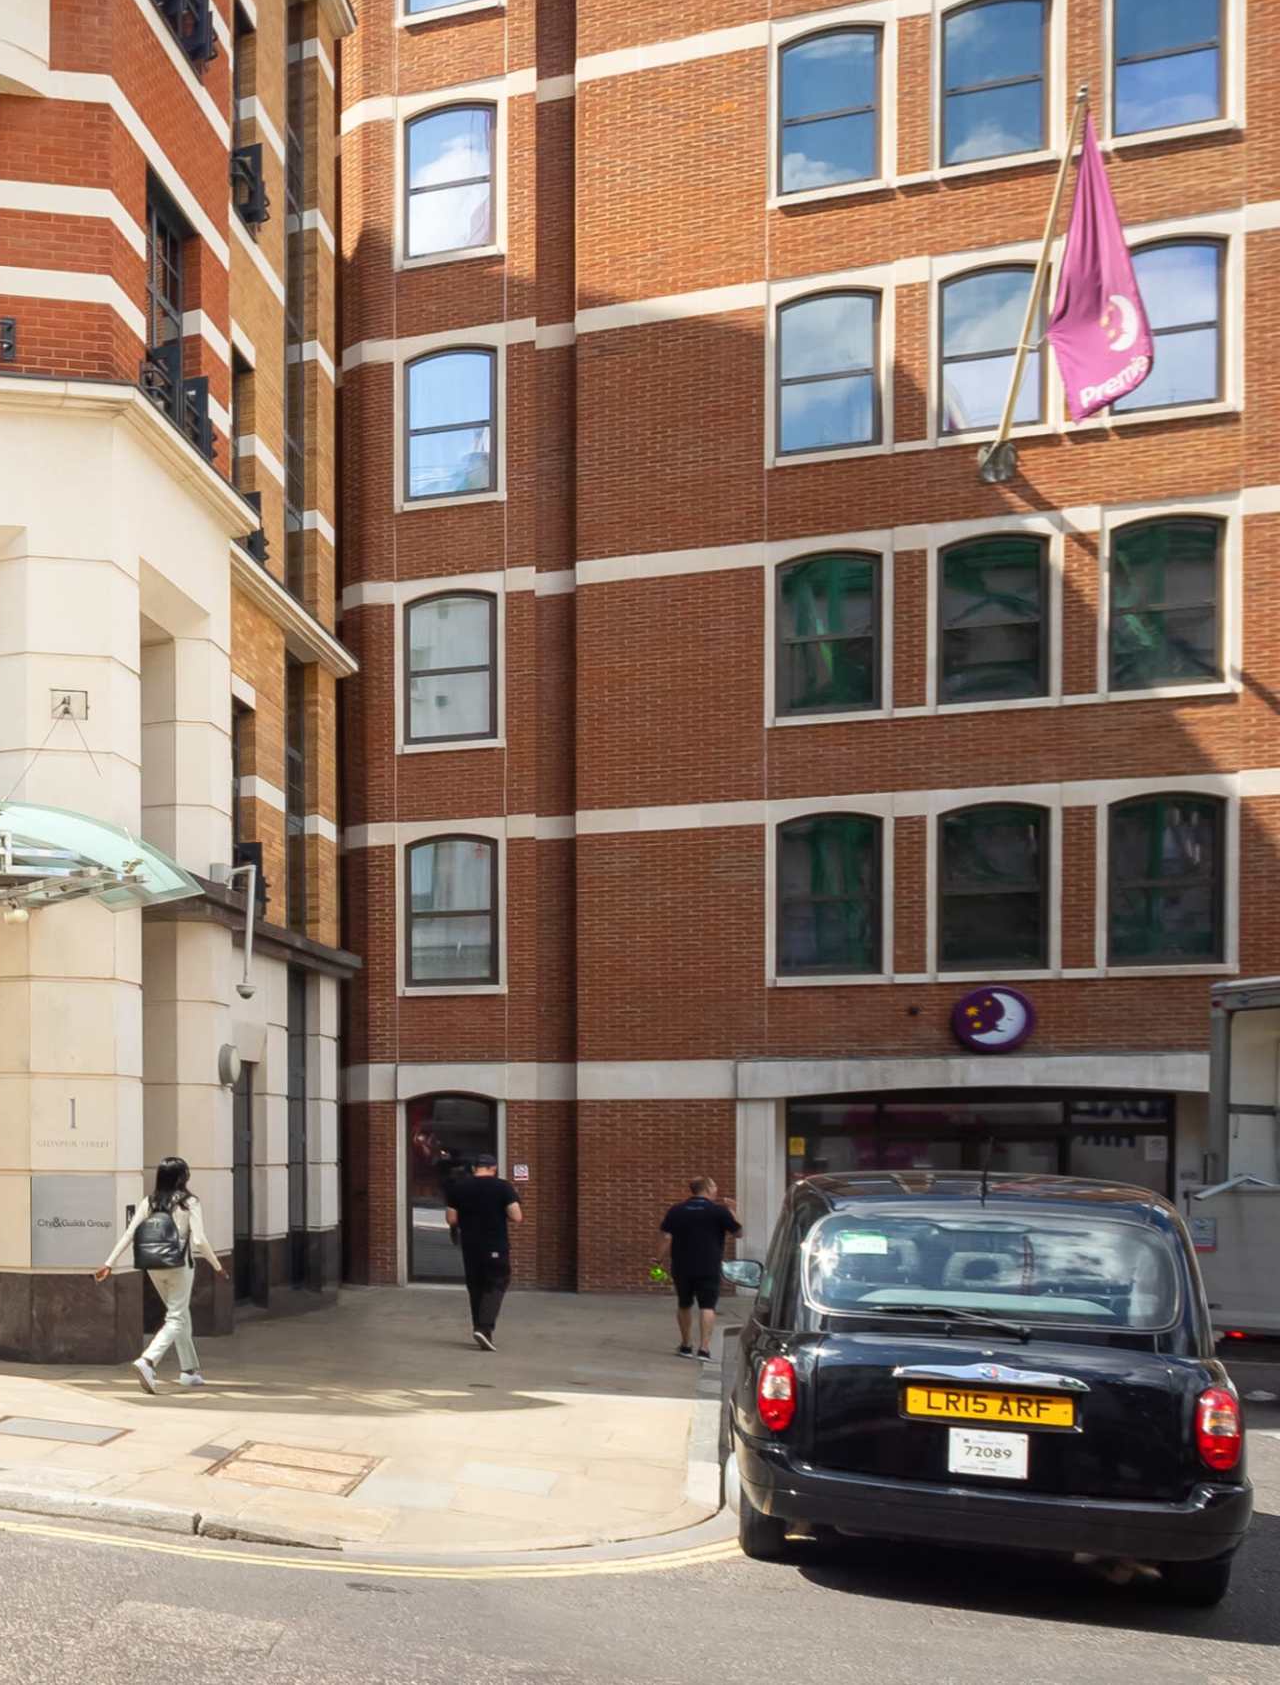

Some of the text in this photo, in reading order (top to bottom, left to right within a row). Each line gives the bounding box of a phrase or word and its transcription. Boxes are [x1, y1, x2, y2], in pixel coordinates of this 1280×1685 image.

[1080, 355, 1149, 409] Premie
[926, 1389, 1052, 1418] LR15 ARF
[965, 1445, 1012, 1459] 72089
